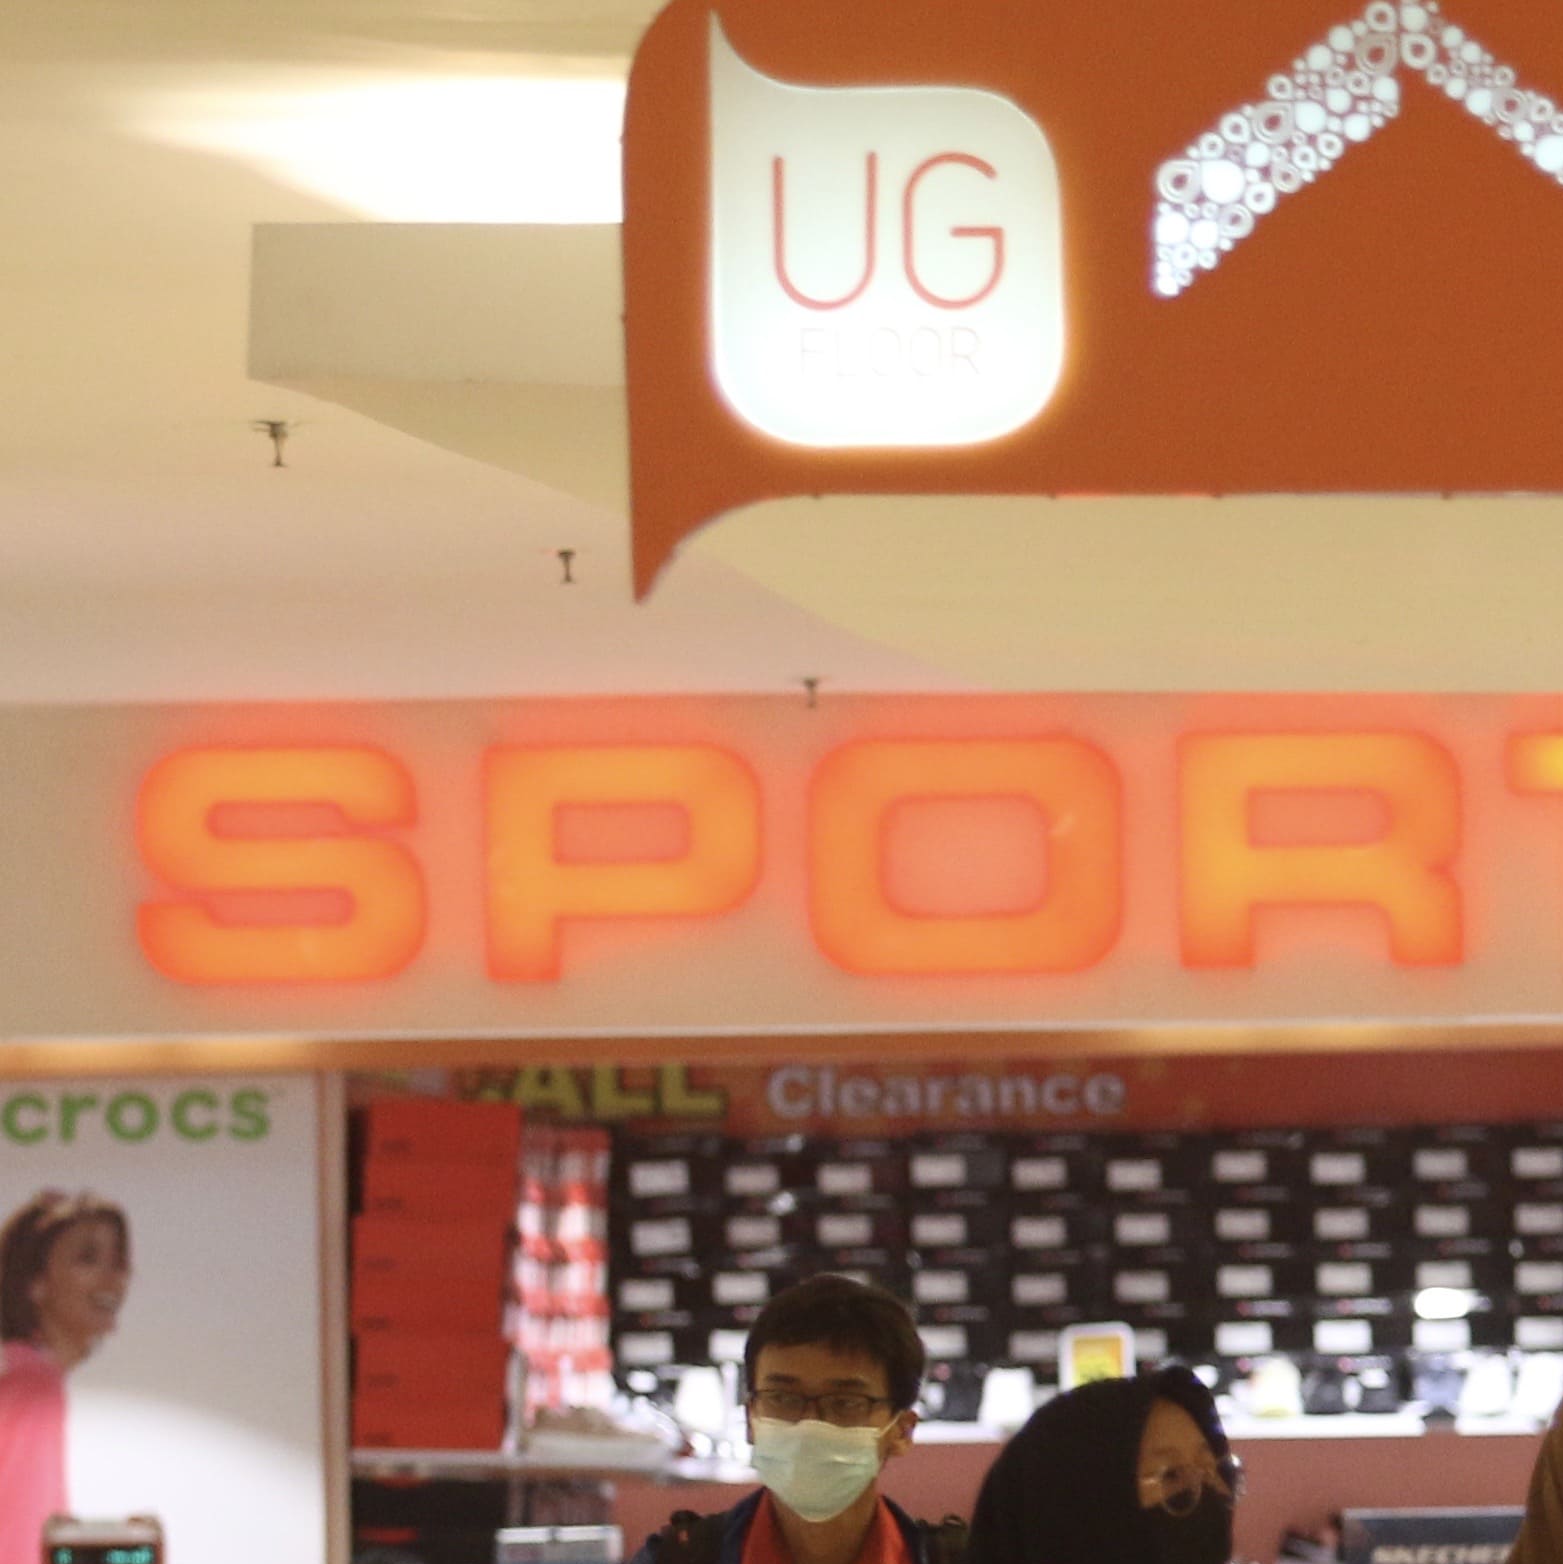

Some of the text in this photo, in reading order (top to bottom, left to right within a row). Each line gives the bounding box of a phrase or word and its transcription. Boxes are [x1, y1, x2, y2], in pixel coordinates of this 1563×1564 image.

[771, 150, 1006, 312] UG
[799, 326, 983, 377] FLOOR
[2, 1087, 271, 1143] crocs
[480, 1063, 724, 1119] ALL
[767, 1063, 1127, 1119] Clearance
